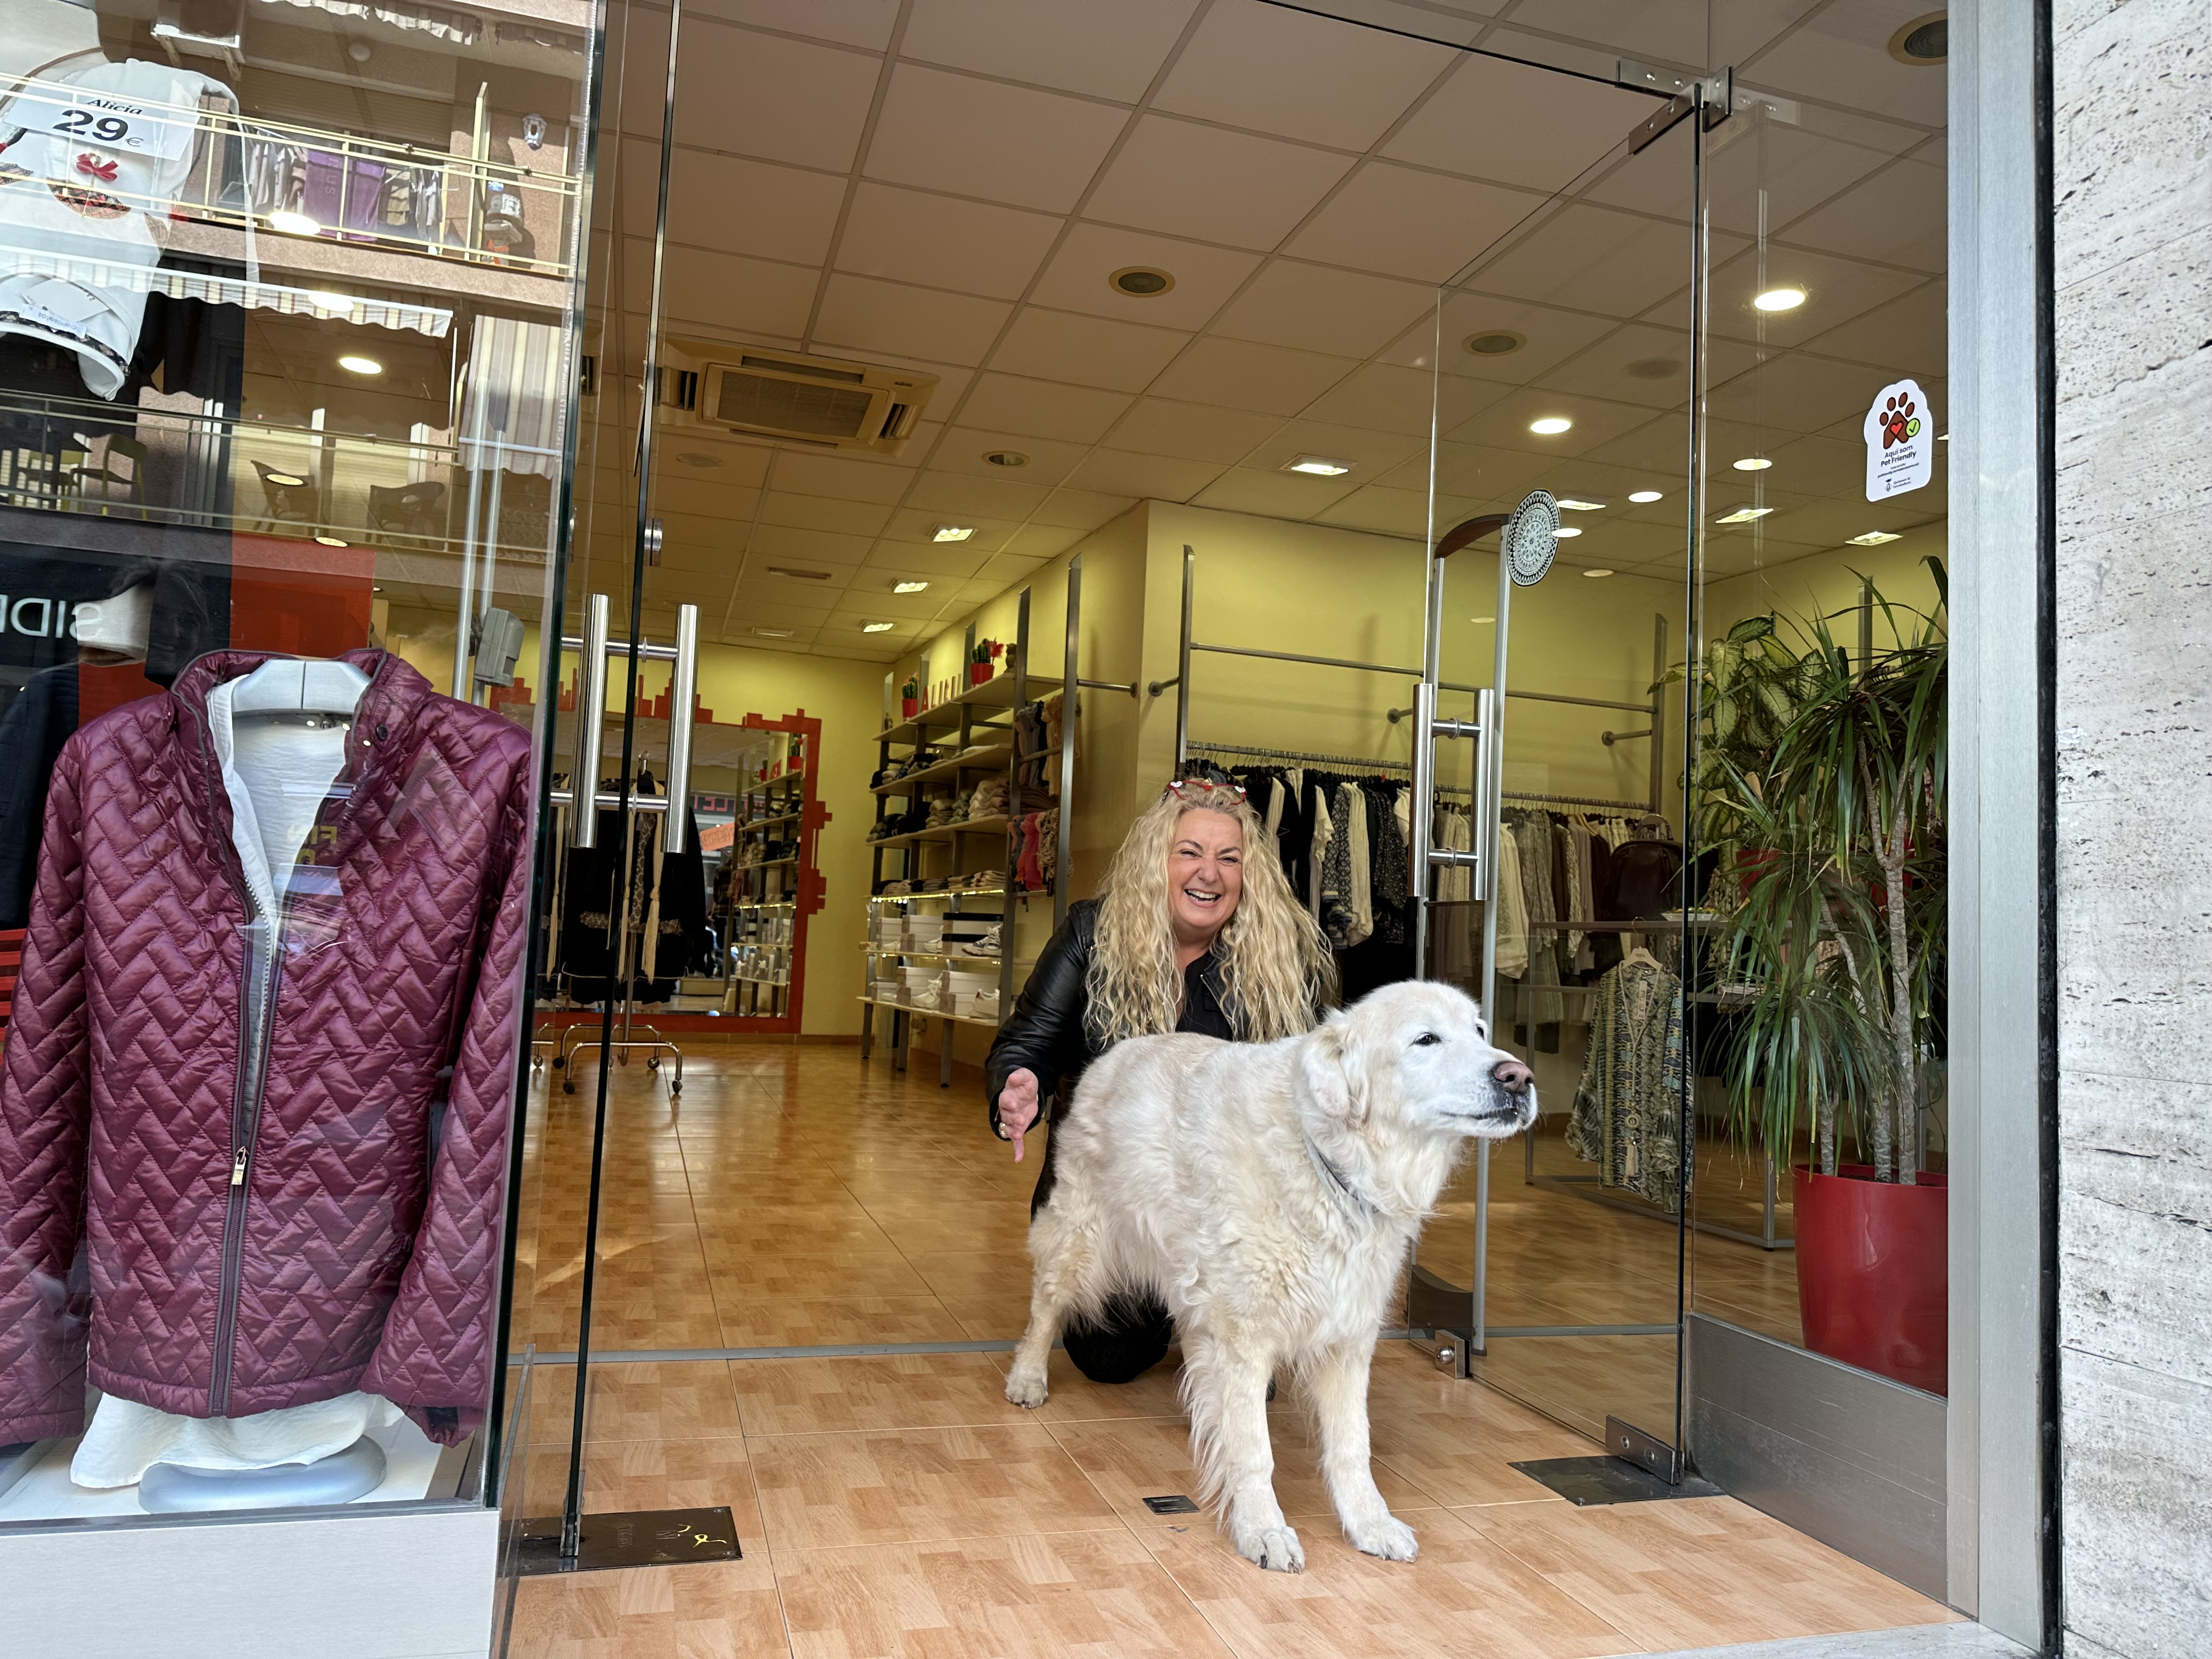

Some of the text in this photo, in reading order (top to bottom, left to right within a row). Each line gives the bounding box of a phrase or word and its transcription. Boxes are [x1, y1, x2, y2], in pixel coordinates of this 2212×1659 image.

[86, 99, 143, 115] Alicia
[1899, 445, 1913, 454] som
[1881, 459, 1891, 467] Pet
[1891, 451, 1917, 464] Friendly
